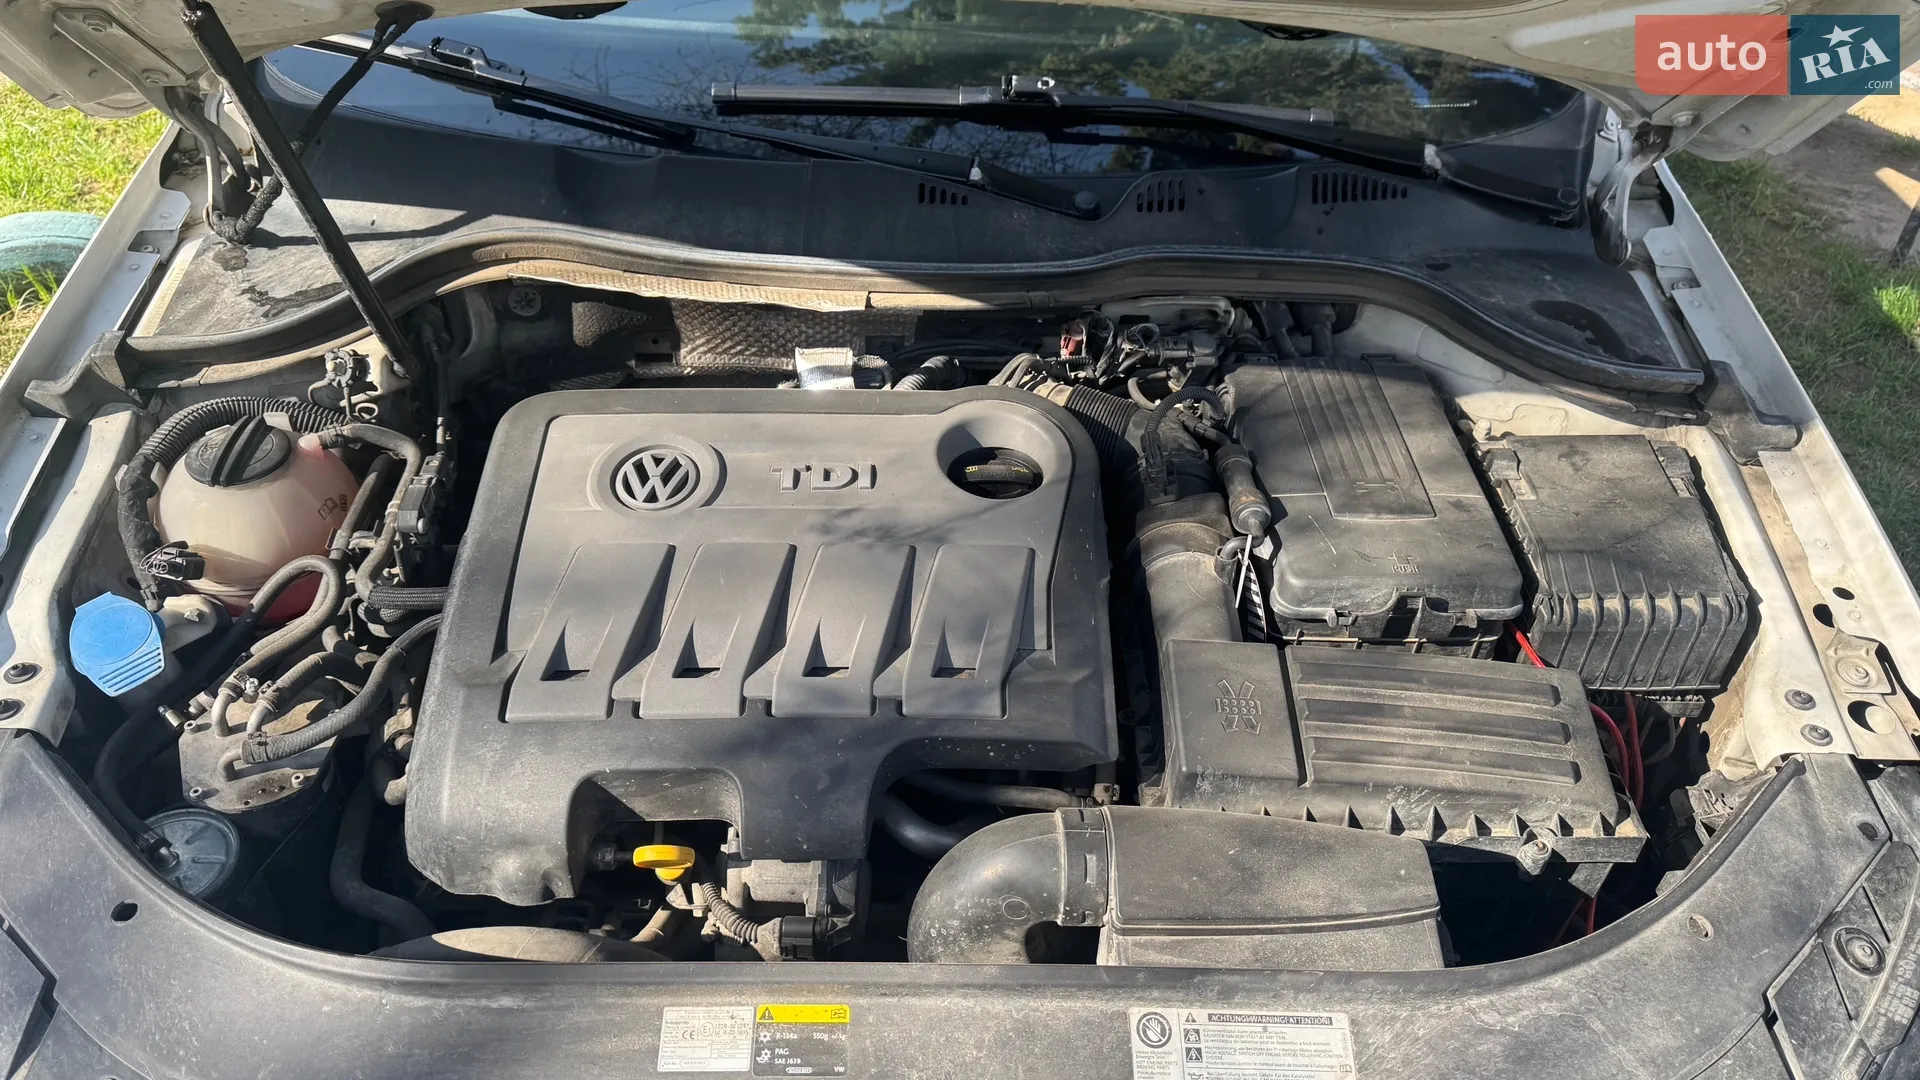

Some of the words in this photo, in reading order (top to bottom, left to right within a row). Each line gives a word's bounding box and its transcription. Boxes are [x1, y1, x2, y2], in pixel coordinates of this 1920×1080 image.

[771, 463, 877, 493] TDI
[1391, 565, 1420, 574] PUSH
[682, 1030, 695, 1040] CE
